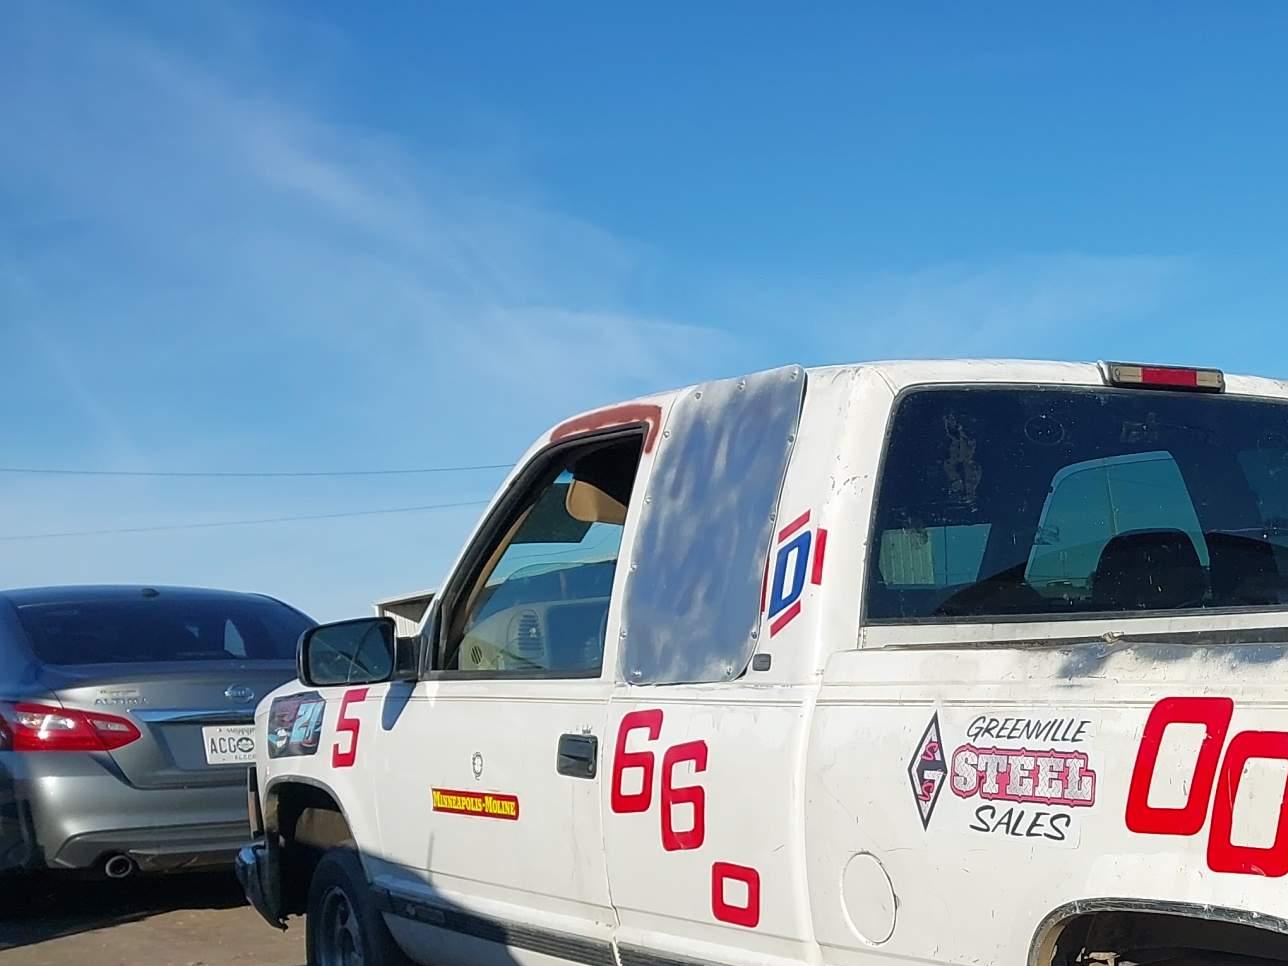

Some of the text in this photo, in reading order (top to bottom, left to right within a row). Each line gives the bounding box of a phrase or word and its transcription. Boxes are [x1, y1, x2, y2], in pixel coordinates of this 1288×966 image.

[331, 687, 370, 769] 5
[966, 715, 1092, 743] GREENVILLE
[951, 744, 1096, 807] STEEL
[969, 804, 1072, 841] SALES
